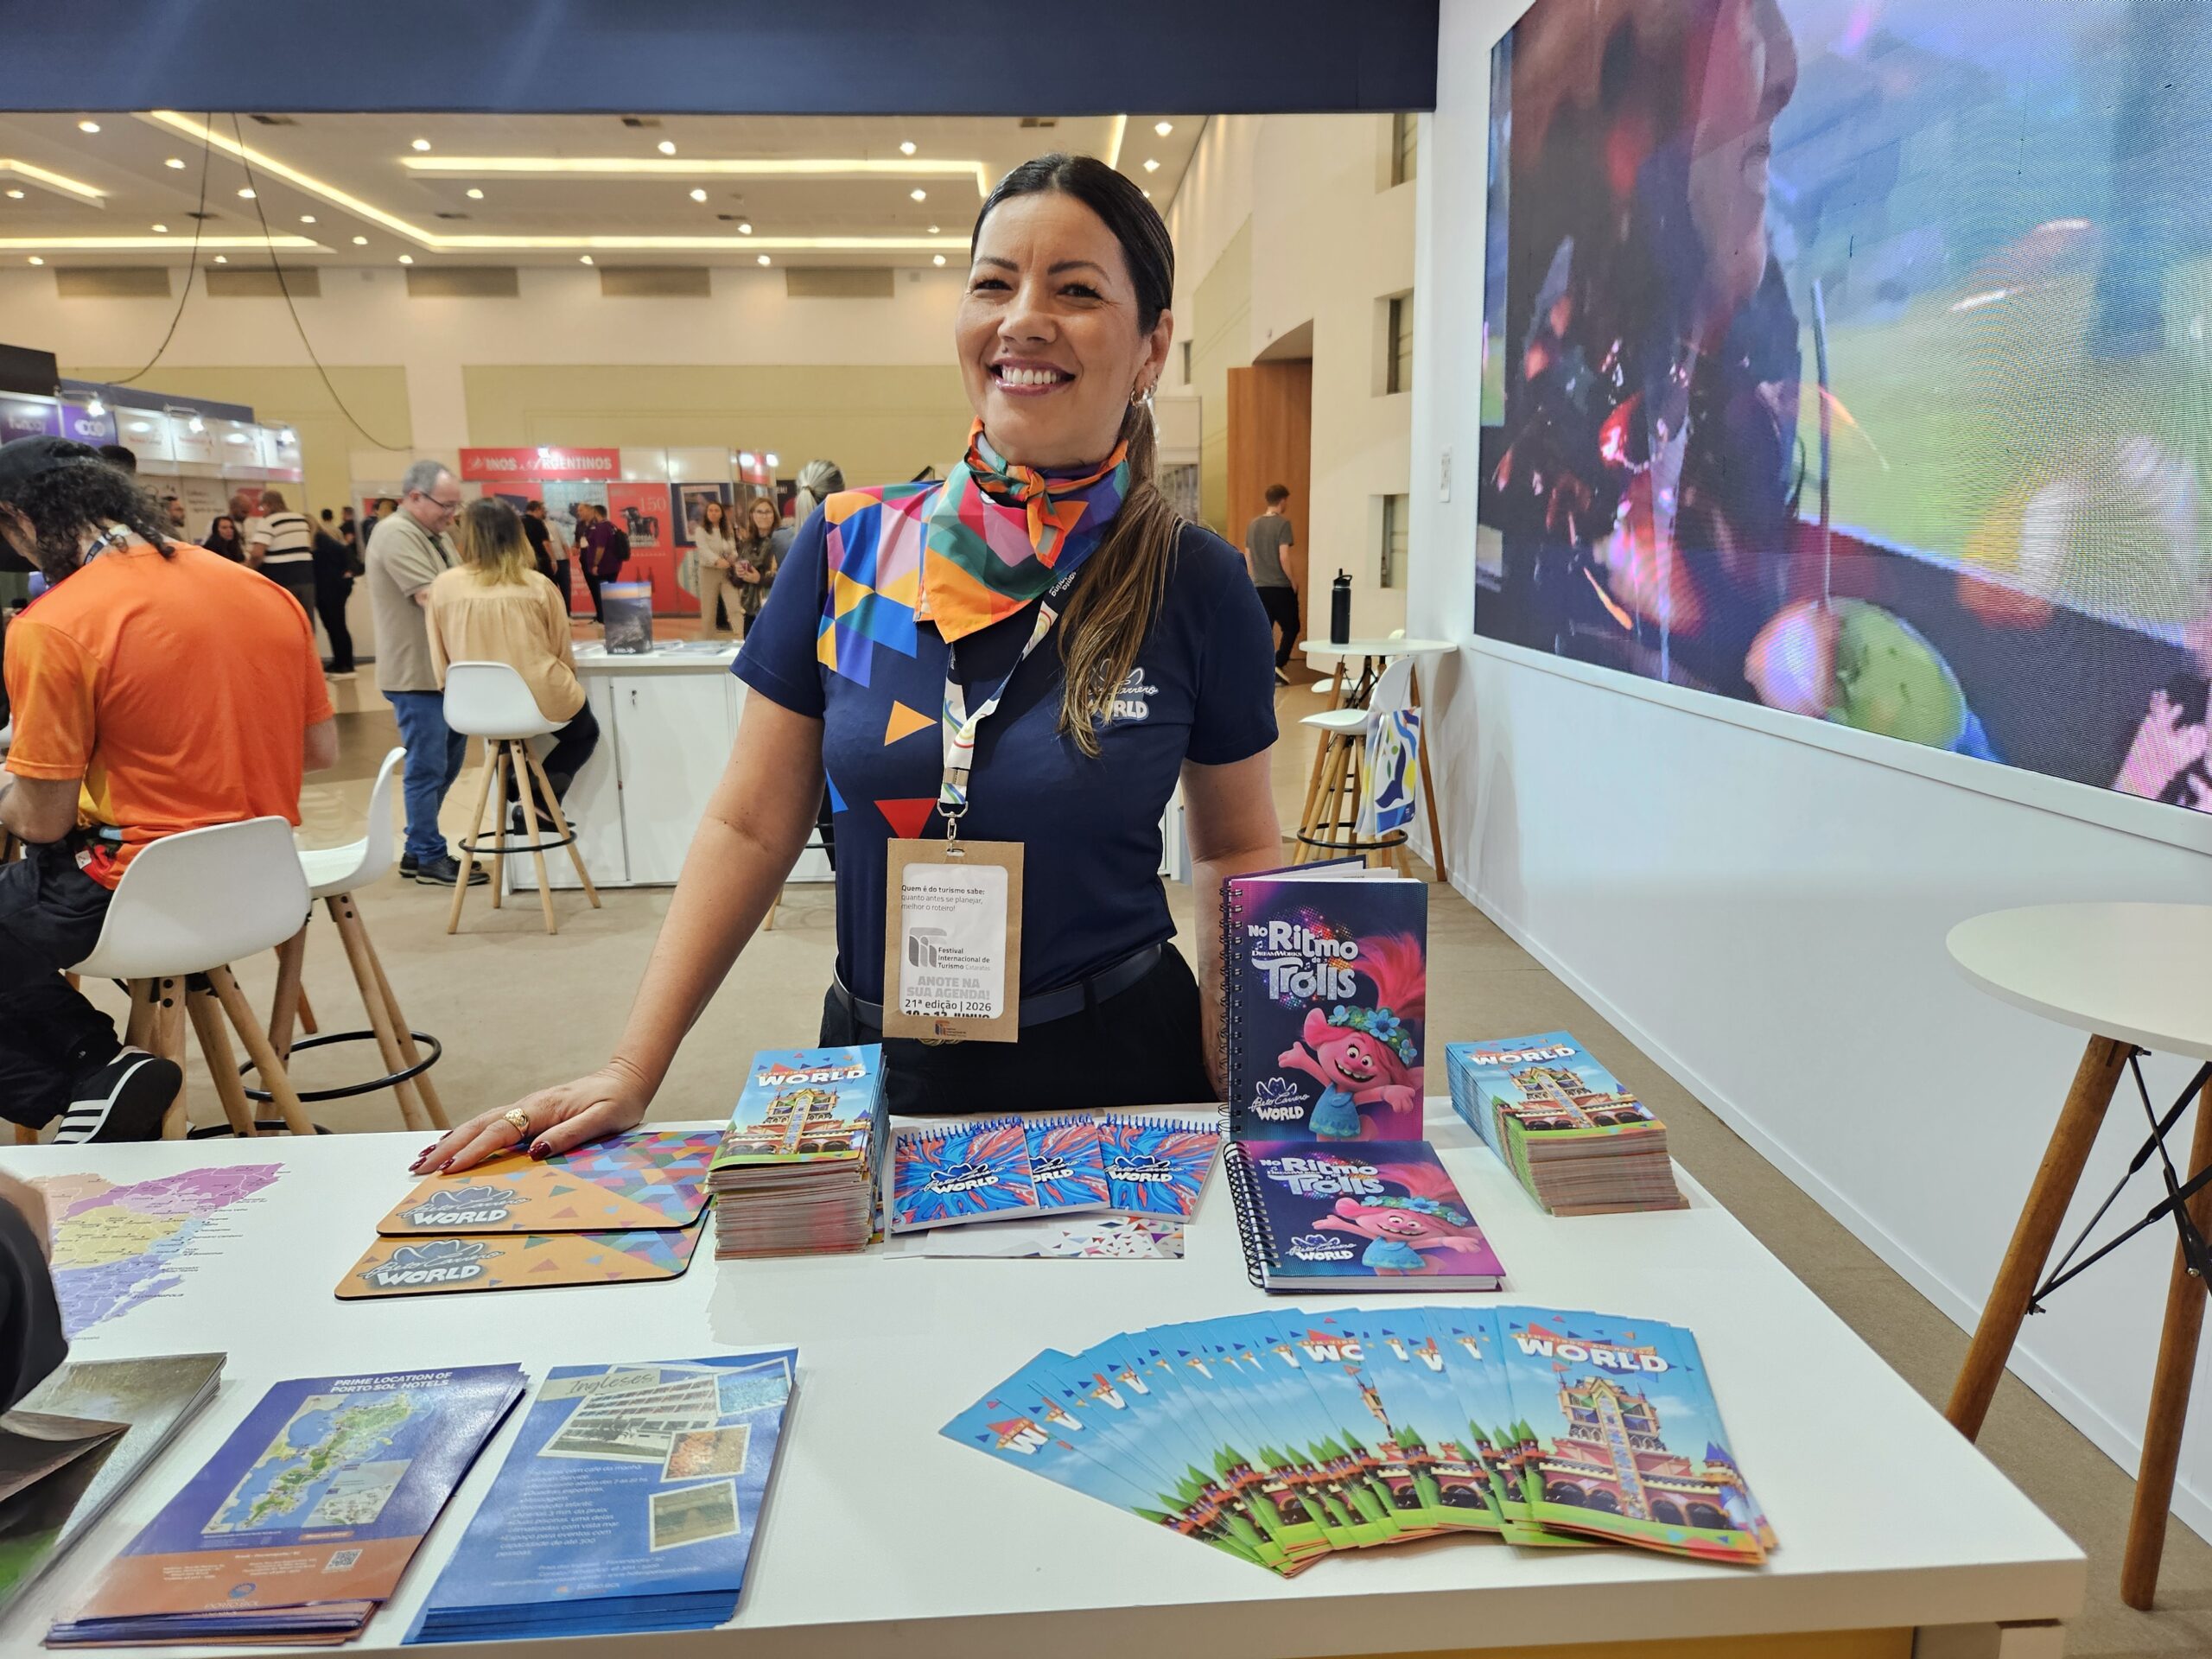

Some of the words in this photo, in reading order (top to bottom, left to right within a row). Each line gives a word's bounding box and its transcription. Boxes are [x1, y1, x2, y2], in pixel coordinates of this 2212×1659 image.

[1247, 925, 1268, 937] No
[1268, 920, 1359, 960] Ritmo
[938, 955, 981, 963] Internacional
[918, 976, 959, 988] ANOTE
[962, 978, 981, 988] NA
[1251, 957, 1357, 1000] Trolls
[906, 987, 932, 998] SUA
[935, 988, 990, 1001] AGENDA!
[925, 1000, 957, 1011] edição
[966, 1001, 992, 1012] 2026
[1471, 1047, 1576, 1065] WORLD
[759, 1070, 867, 1087] WORLD
[1248, 1096, 1275, 1112] Beto
[1274, 1091, 1310, 1104] Carrero
[1255, 1105, 1304, 1121] WORLD
[1281, 1157, 1378, 1175] Ritmo
[931, 1175, 1000, 1194] WORLD
[1108, 1171, 1173, 1183] WORLD
[1267, 1174, 1385, 1195] Trolls
[414, 1210, 507, 1225] WORLD
[1295, 1249, 1354, 1261] WORLD
[377, 1265, 481, 1286] WORLD
[1516, 1338, 1669, 1372] WORLD
[330, 1384, 372, 1394] PORTO
[373, 1382, 397, 1391] SOL
[401, 1379, 449, 1389] HOTELS
[334, 1377, 374, 1387] PRIME
[374, 1373, 434, 1384] LOCATION
[565, 1372, 655, 1395] Ingleses
